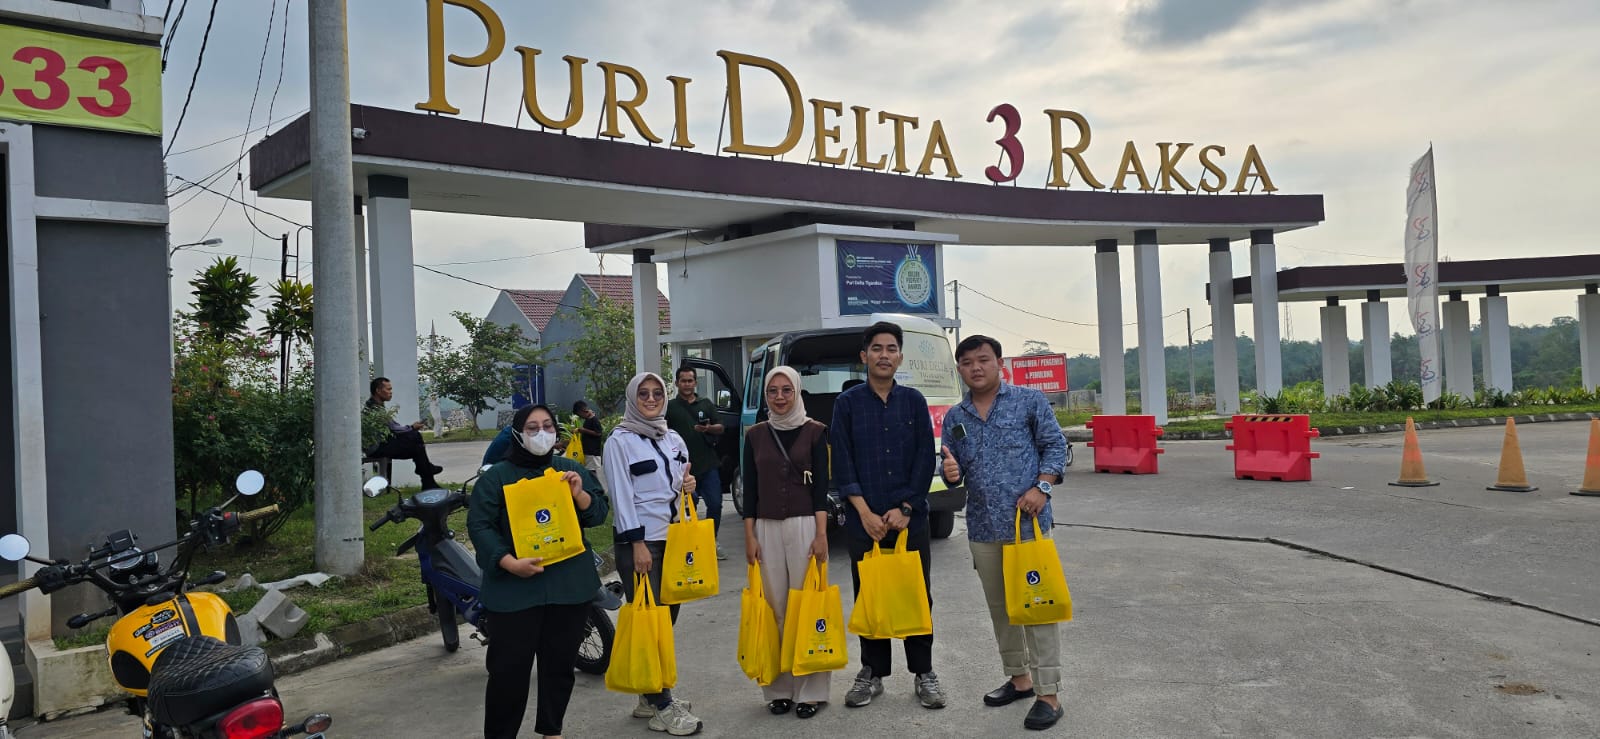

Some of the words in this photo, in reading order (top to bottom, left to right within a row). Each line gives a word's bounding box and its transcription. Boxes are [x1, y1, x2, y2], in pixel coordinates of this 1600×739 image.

[0, 46, 131, 118] 33
[415, 0, 695, 149] PURI
[717, 50, 962, 178] DELTA
[985, 103, 1025, 183] 3
[1043, 108, 1278, 193] RAKSA
